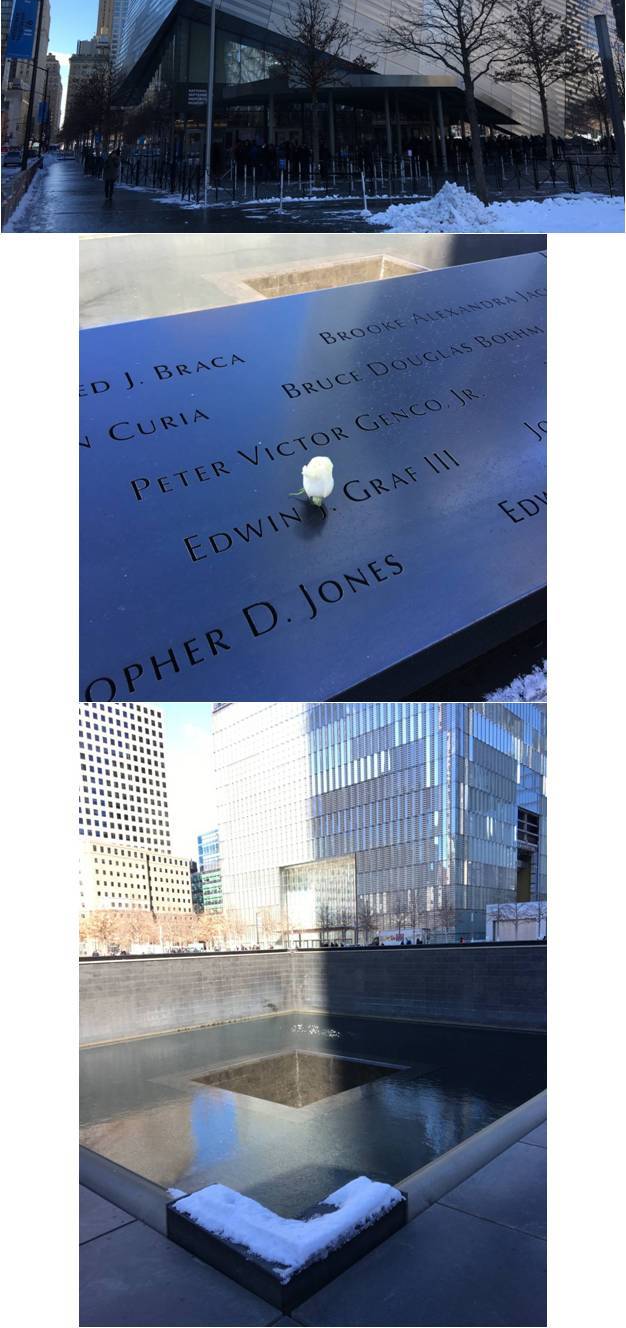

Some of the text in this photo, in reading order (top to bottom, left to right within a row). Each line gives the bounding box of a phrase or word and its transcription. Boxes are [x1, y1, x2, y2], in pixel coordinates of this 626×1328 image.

[319, 319, 407, 345] BROOKE
[412, 295, 517, 325] ALEXANDRA
[124, 372, 144, 390] J.
[153, 354, 246, 380] BRACA
[281, 325, 544, 399] BRUCE DOUGLAS BOEHM
[108, 409, 210, 441] CURIA
[130, 461, 230, 501] PETER
[237, 427, 349, 467] VICTOR
[450, 388, 487, 407] JR.
[184, 507, 302, 562] EDWIN
[343, 467, 417, 502] GRAF
[424, 449, 460, 473] III
[84, 554, 404, 702] OPHER D. JONES
